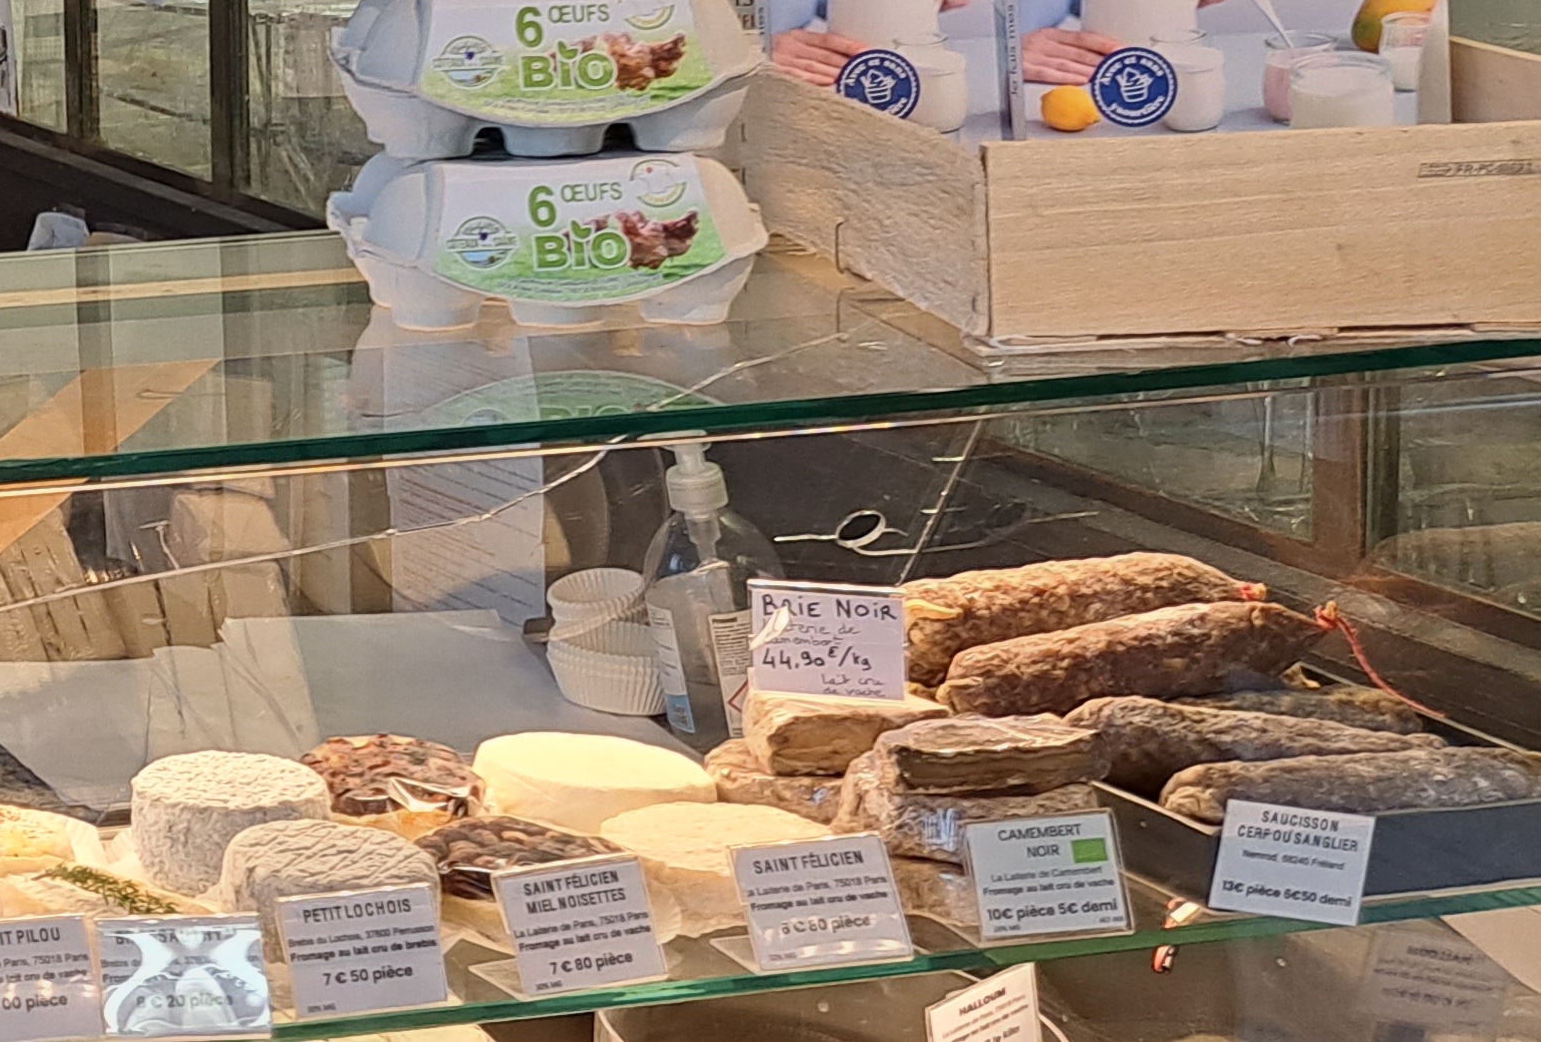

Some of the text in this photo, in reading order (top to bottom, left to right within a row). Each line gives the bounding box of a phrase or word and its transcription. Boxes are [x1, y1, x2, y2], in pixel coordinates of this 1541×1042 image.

[516, 5, 544, 48] 6
[528, 185, 557, 228] 6
[998, 823, 1082, 841] CAMEMBERT
[1261, 810, 1340, 832] SAUCISSON
[1026, 845, 1060, 858] NOIR
[1237, 824, 1272, 842] CERF
[1294, 832, 1359, 853] SANGLIER
[753, 850, 865, 875] SAINT FÉLICIEN
[523, 869, 620, 897] SAINT FÉLICIEN
[1222, 880, 1353, 907] 13€ pièce 6€50 demi
[303, 897, 412, 925] PETIT LOCHOIS
[526, 887, 627, 915] MIEL NOISETTES
[986, 897, 1119, 923] 10€ pièce 5€ demi
[16, 926, 62, 944] PILOU
[290, 937, 438, 964] Fromage brebis
[548, 950, 634, 976] 7 80 pièce
[322, 964, 415, 987] 7 50 pièce
[25, 993, 69, 1013] pièce
